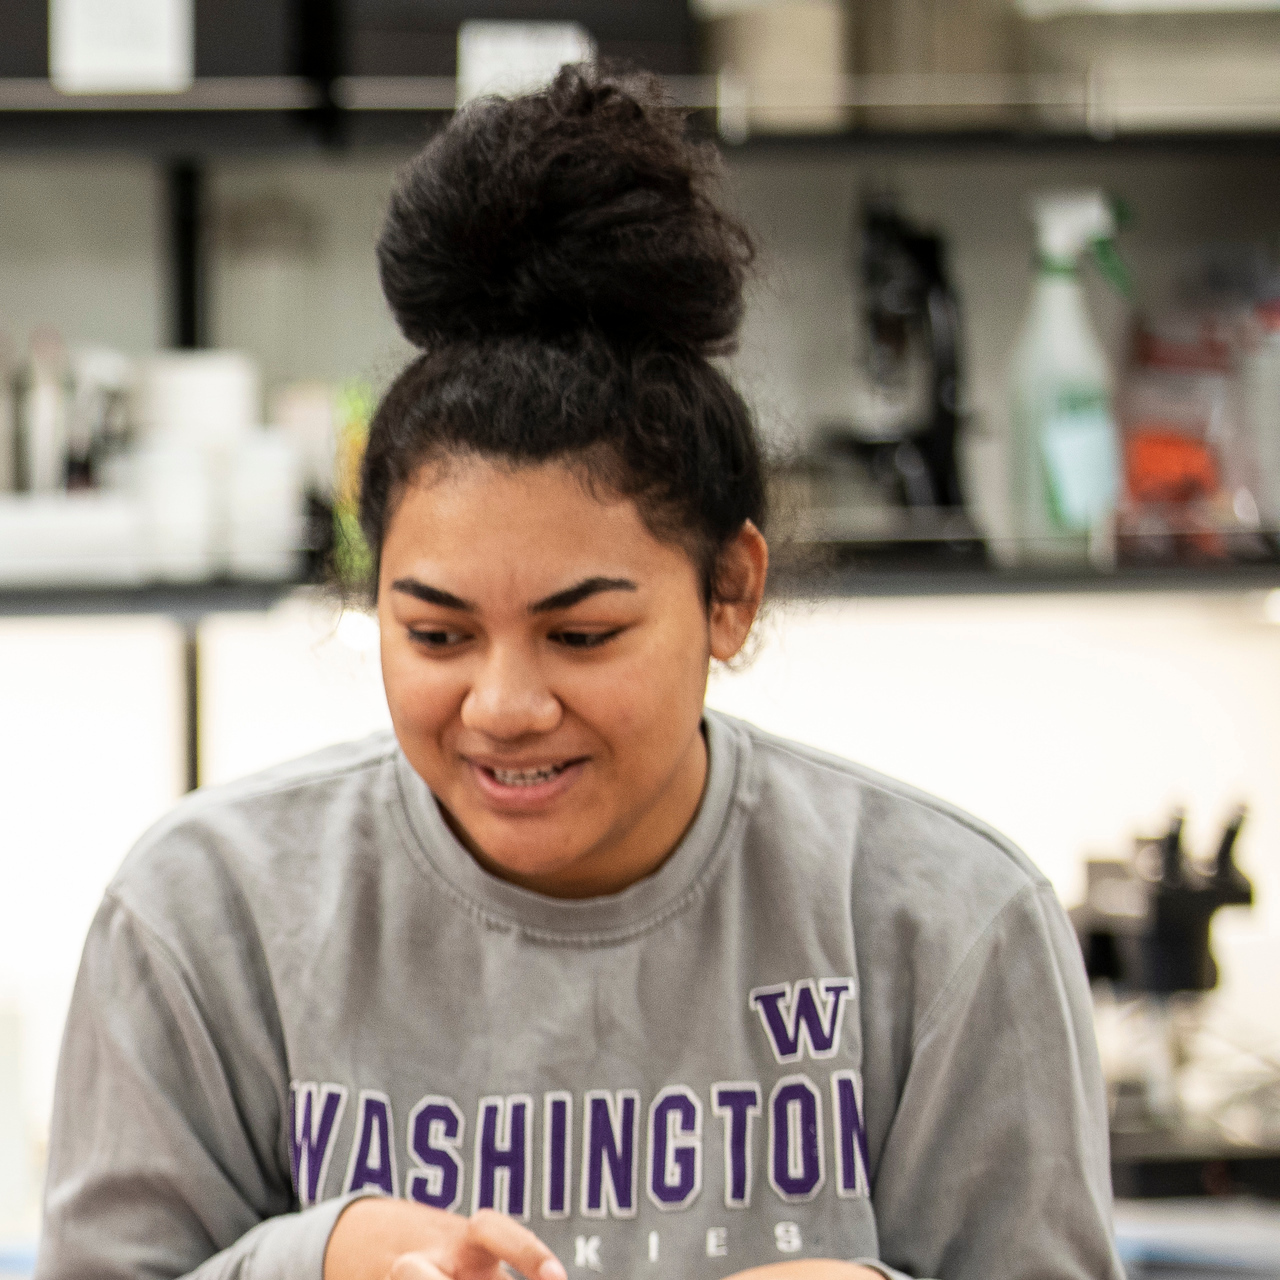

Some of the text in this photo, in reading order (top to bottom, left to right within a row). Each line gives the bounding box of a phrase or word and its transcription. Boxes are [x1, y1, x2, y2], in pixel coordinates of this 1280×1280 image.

[749, 977, 854, 1064] W
[290, 1069, 870, 1222] WASHINGTON
[574, 1220, 803, 1272] KIES
